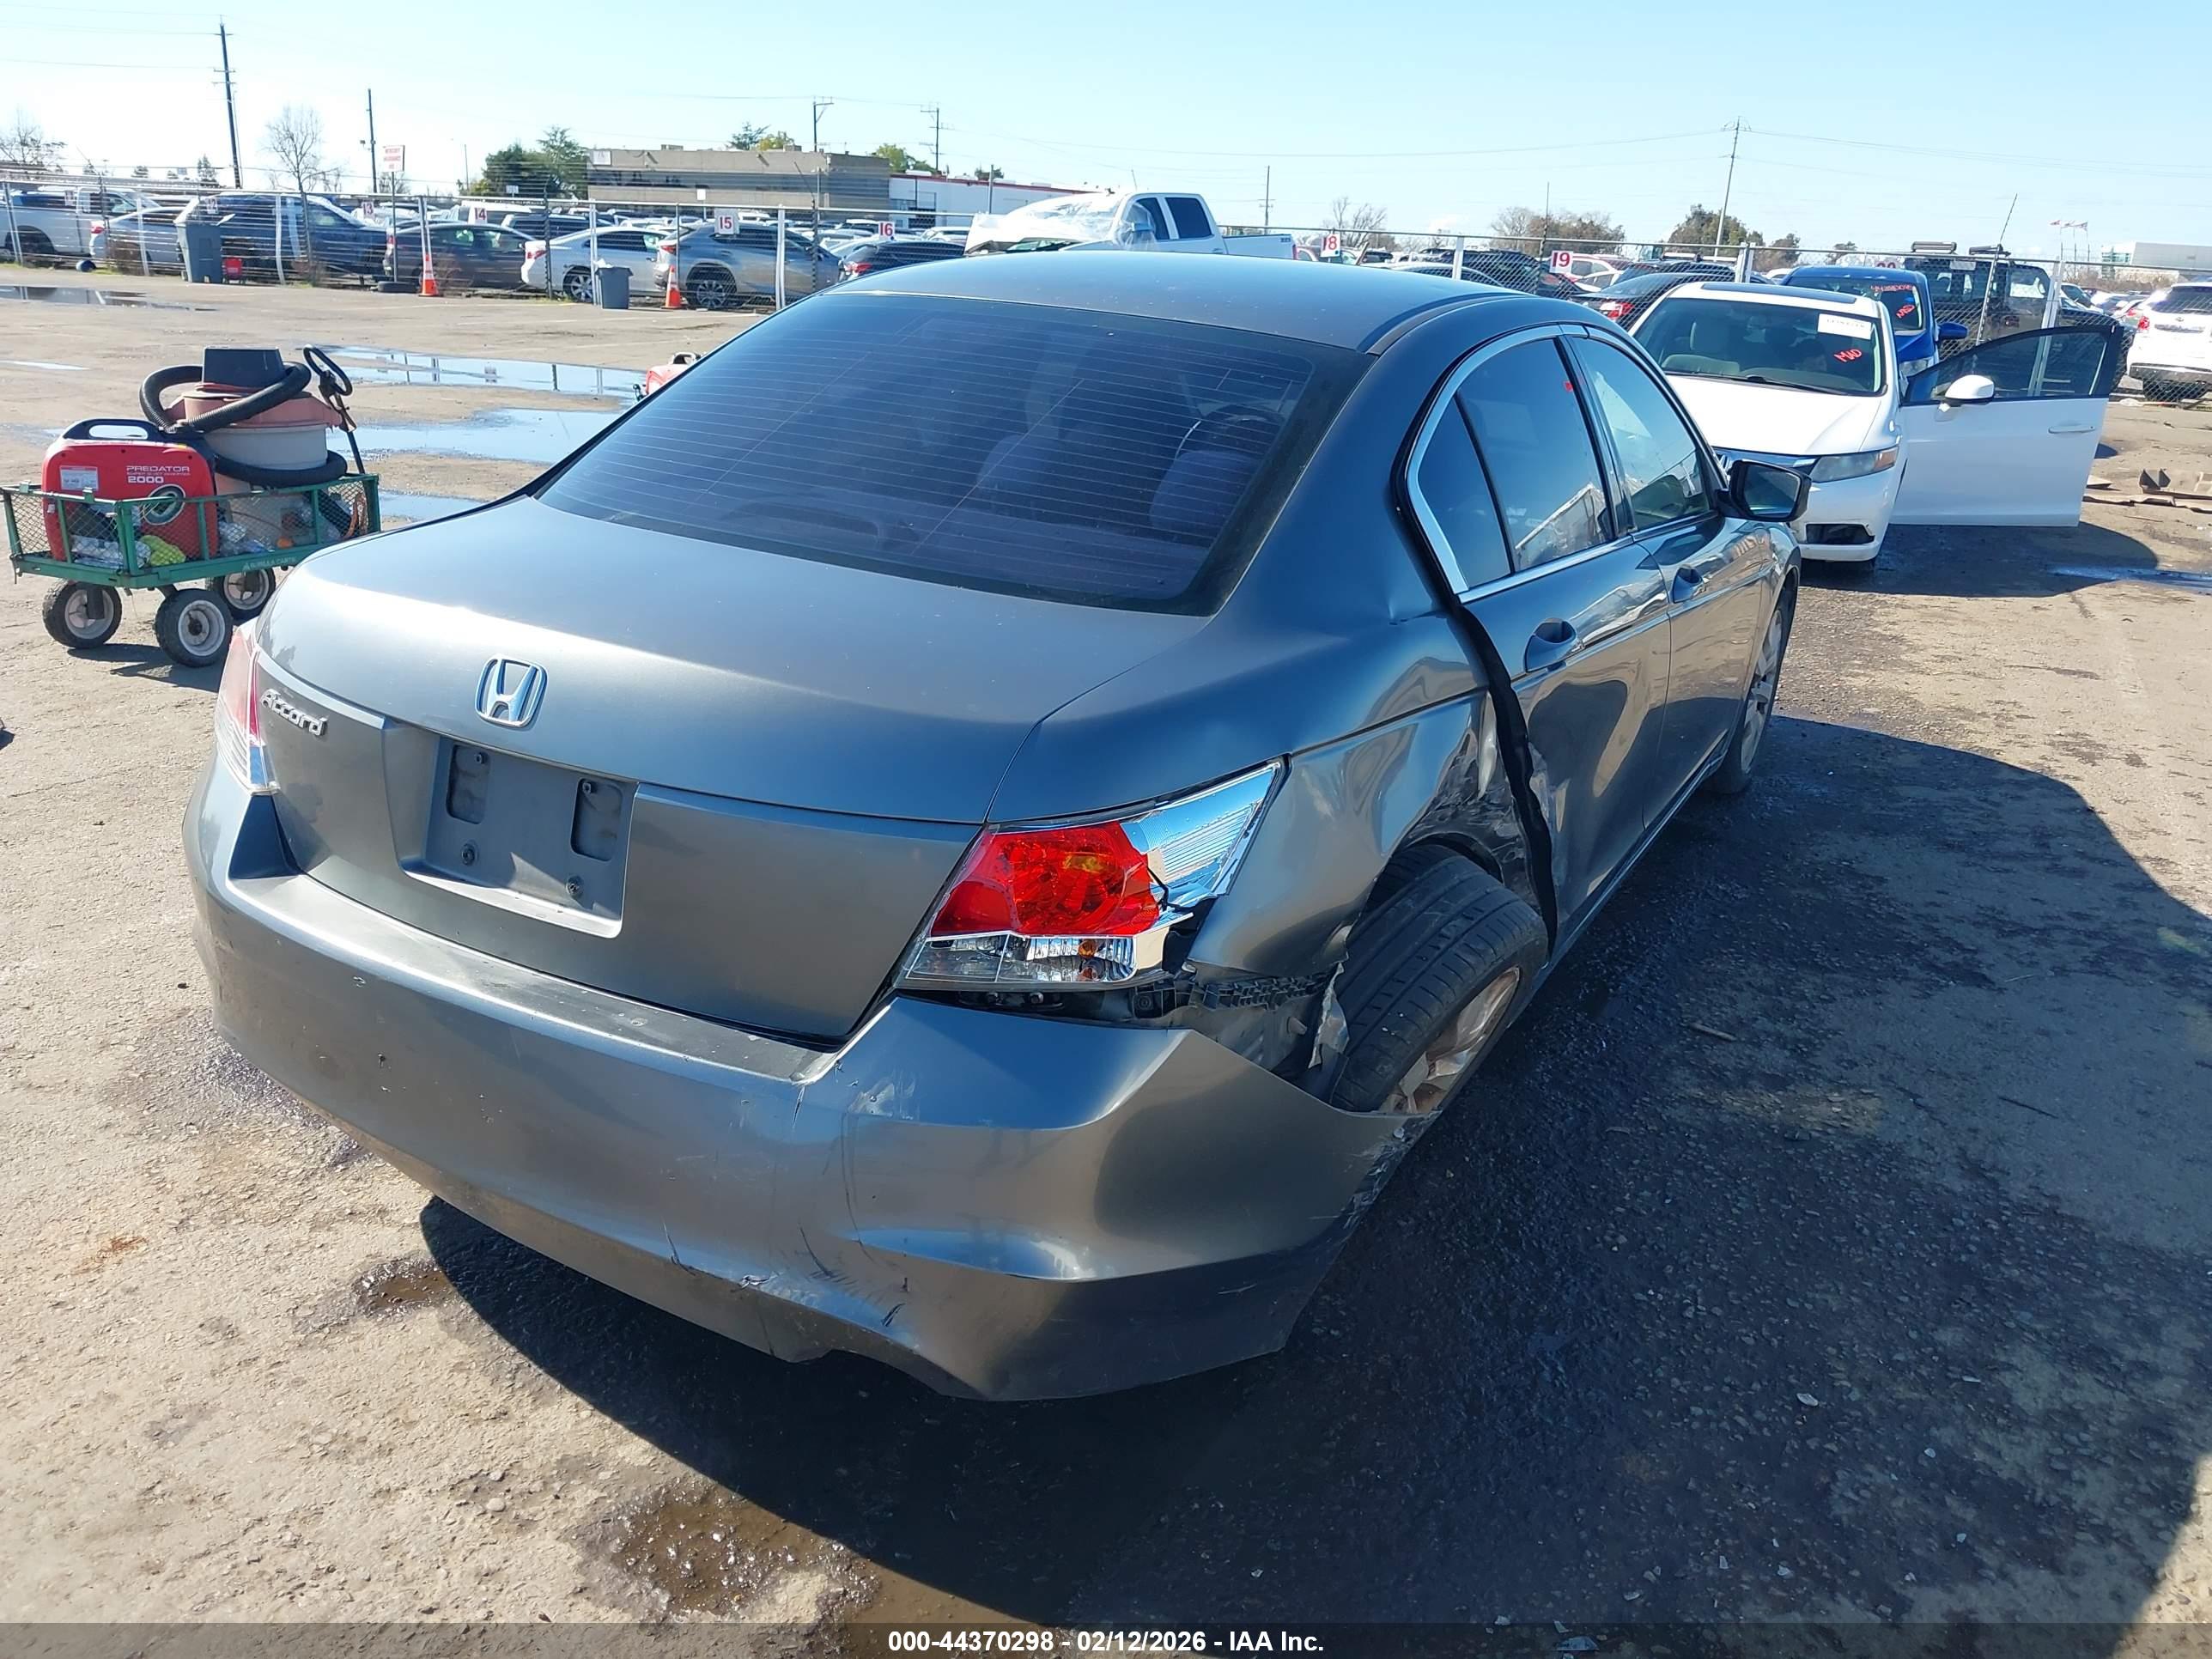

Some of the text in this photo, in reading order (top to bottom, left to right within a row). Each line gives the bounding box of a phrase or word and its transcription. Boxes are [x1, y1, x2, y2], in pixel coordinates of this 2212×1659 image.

[362, 203, 374, 215] 13
[474, 207, 486, 221] 14
[719, 216, 732, 230] 15
[879, 222, 893, 237] 16
[1323, 235, 1337, 251] 18
[1552, 252, 1571, 268] 19
[260, 689, 327, 736] Accord
